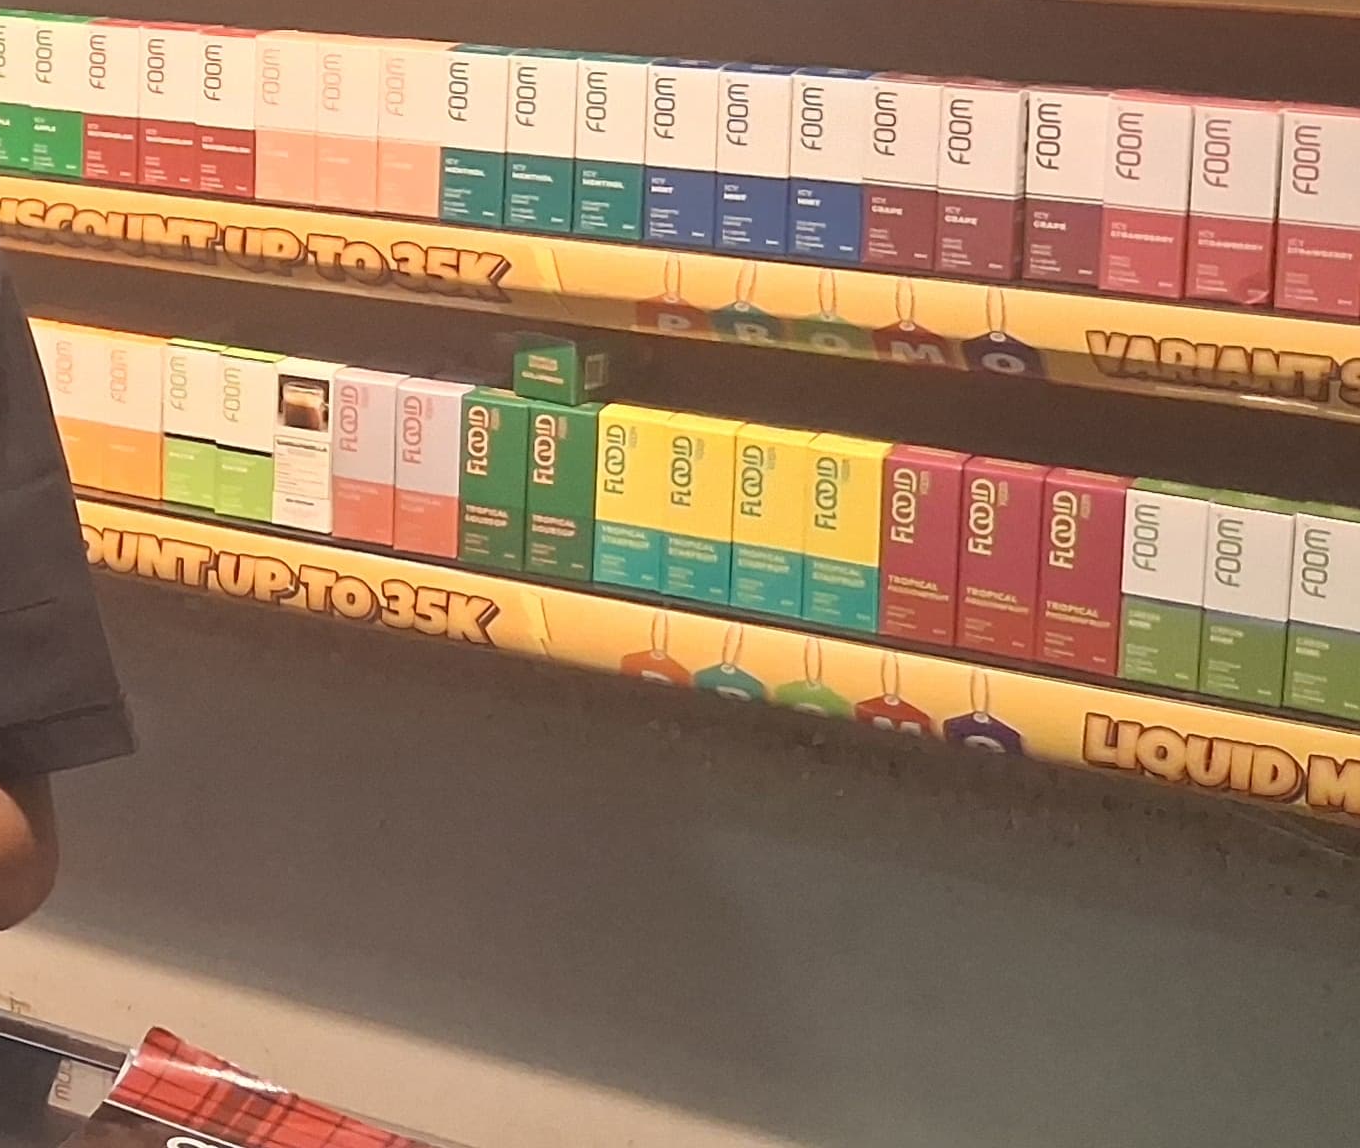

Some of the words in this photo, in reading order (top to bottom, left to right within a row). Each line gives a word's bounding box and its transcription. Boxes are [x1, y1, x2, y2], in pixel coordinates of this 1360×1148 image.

[35, 29, 53, 84] FOOM
[88, 35, 107, 89] FOOM
[147, 38, 165, 94] FOOM
[203, 44, 222, 101] FOOM
[448, 62, 469, 122] FOOM
[514, 66, 536, 127] FOOM
[586, 71, 608, 133] FOOM
[653, 77, 676, 139] FOOM
[726, 83, 749, 146] FOOM
[801, 87, 824, 150] FOOM
[873, 92, 897, 156] FOOM
[947, 98, 973, 165] FOOM
[1036, 102, 1062, 170] FOOM
[1115, 112, 1144, 180] FOOM
[1203, 119, 1231, 188] FOOM
[1292, 124, 1322, 195] FOOM
[223, 226, 306, 277] UP
[306, 234, 393, 285] TO
[392, 242, 512, 303] 35K
[1132, 503, 1161, 571] FOOM
[1215, 517, 1244, 588] FOOM
[1301, 528, 1331, 598] FOOM
[215, 551, 298, 602] UP
[298, 564, 380, 620] TO
[380, 578, 501, 647] 35K
[1083, 712, 1306, 805] LIQUID
